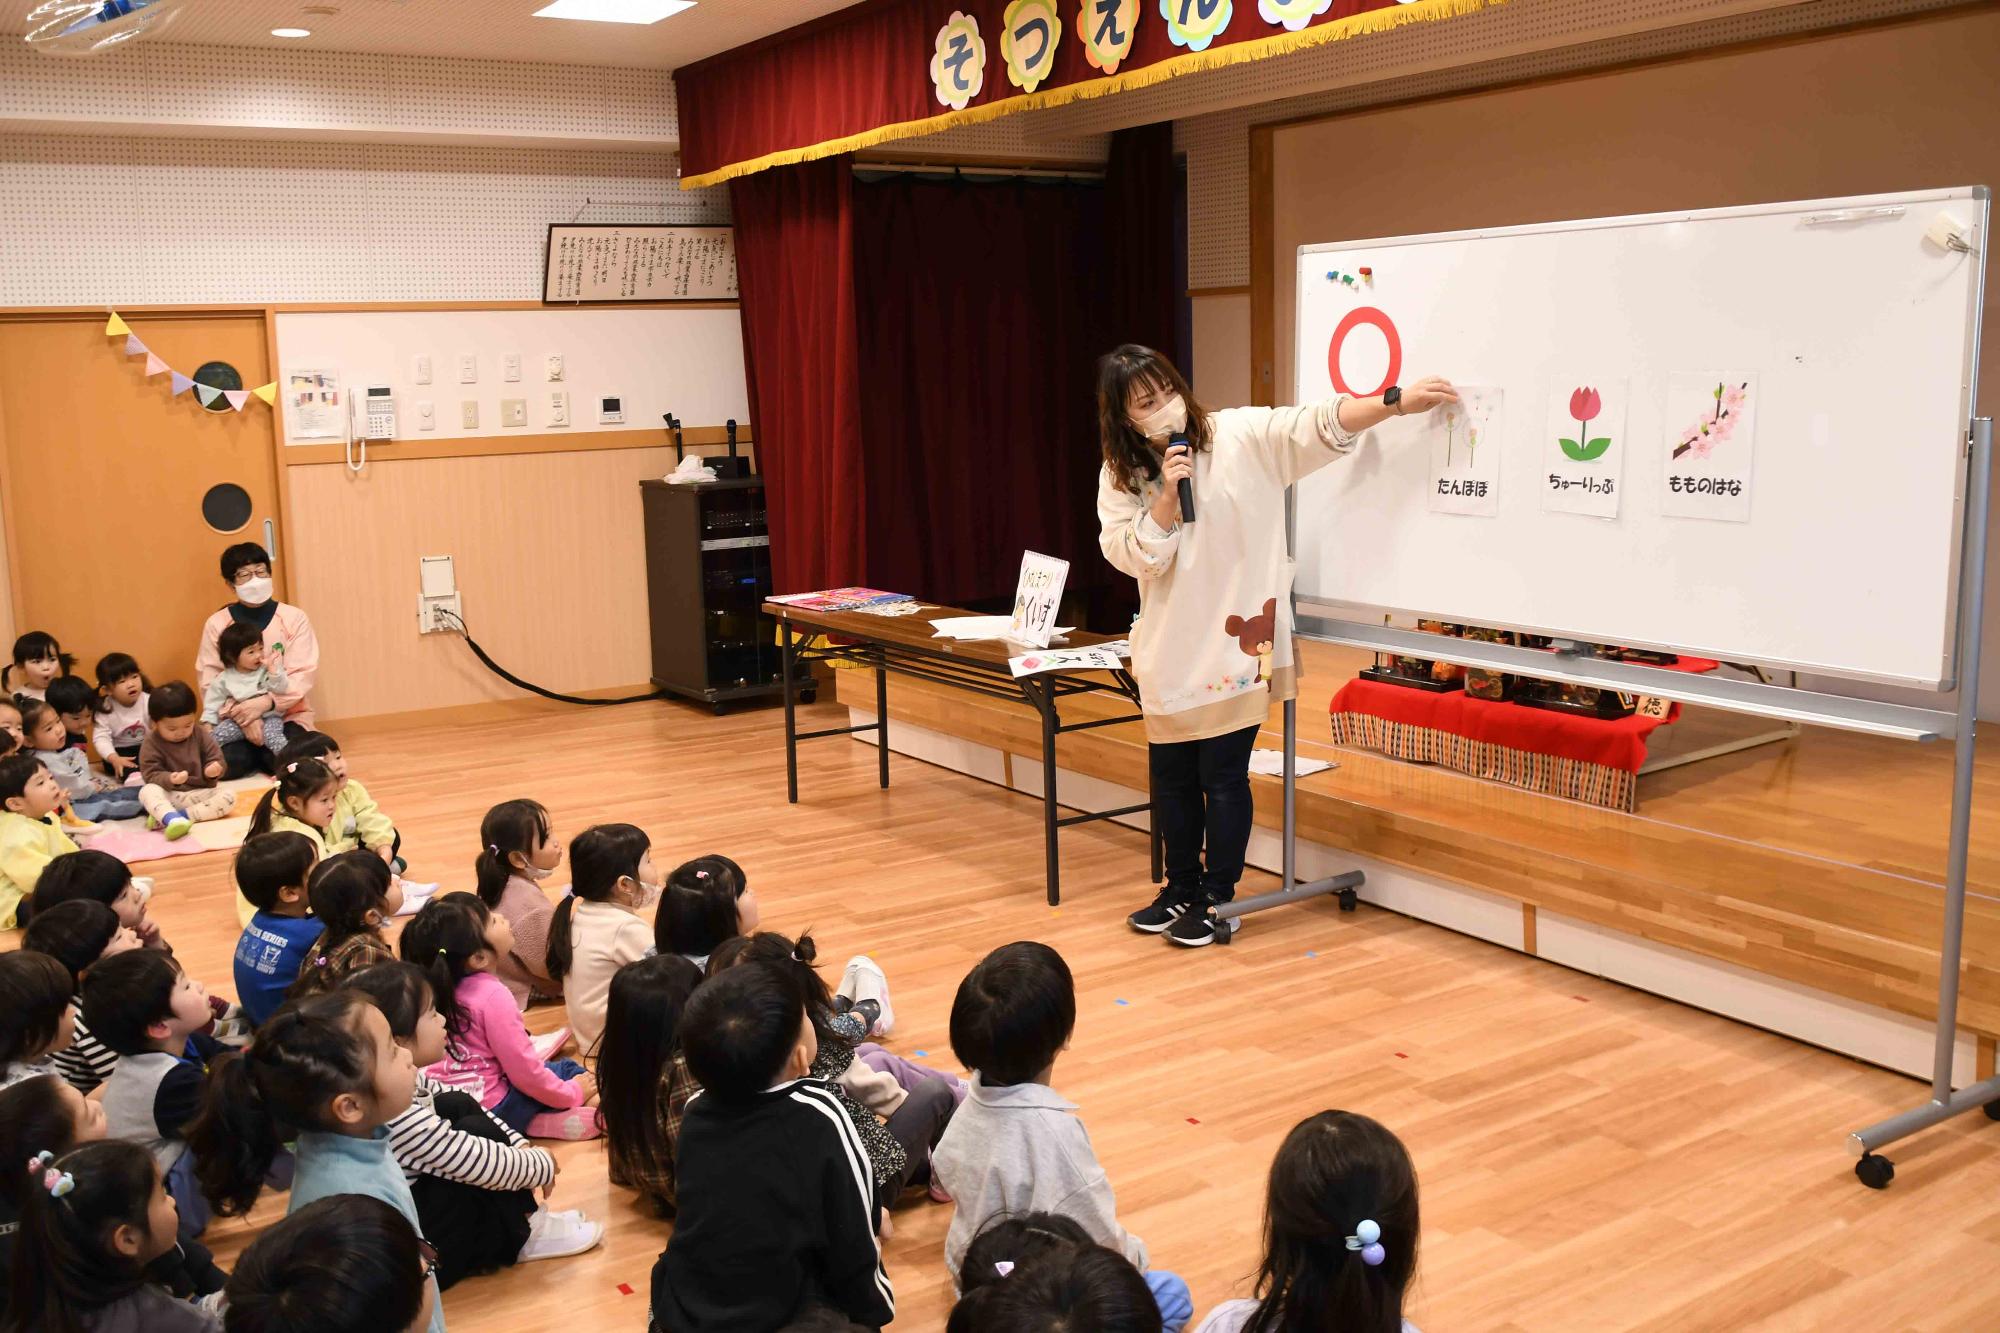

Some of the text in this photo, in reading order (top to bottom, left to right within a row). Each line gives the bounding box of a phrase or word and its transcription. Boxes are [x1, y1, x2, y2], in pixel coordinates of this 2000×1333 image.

[1437, 478, 1489, 497] たんぽぽ
[1549, 473, 1615, 494] ちゅーりっぷ
[1669, 475, 1742, 496] もものはな
[261, 930, 288, 948] SERIES
